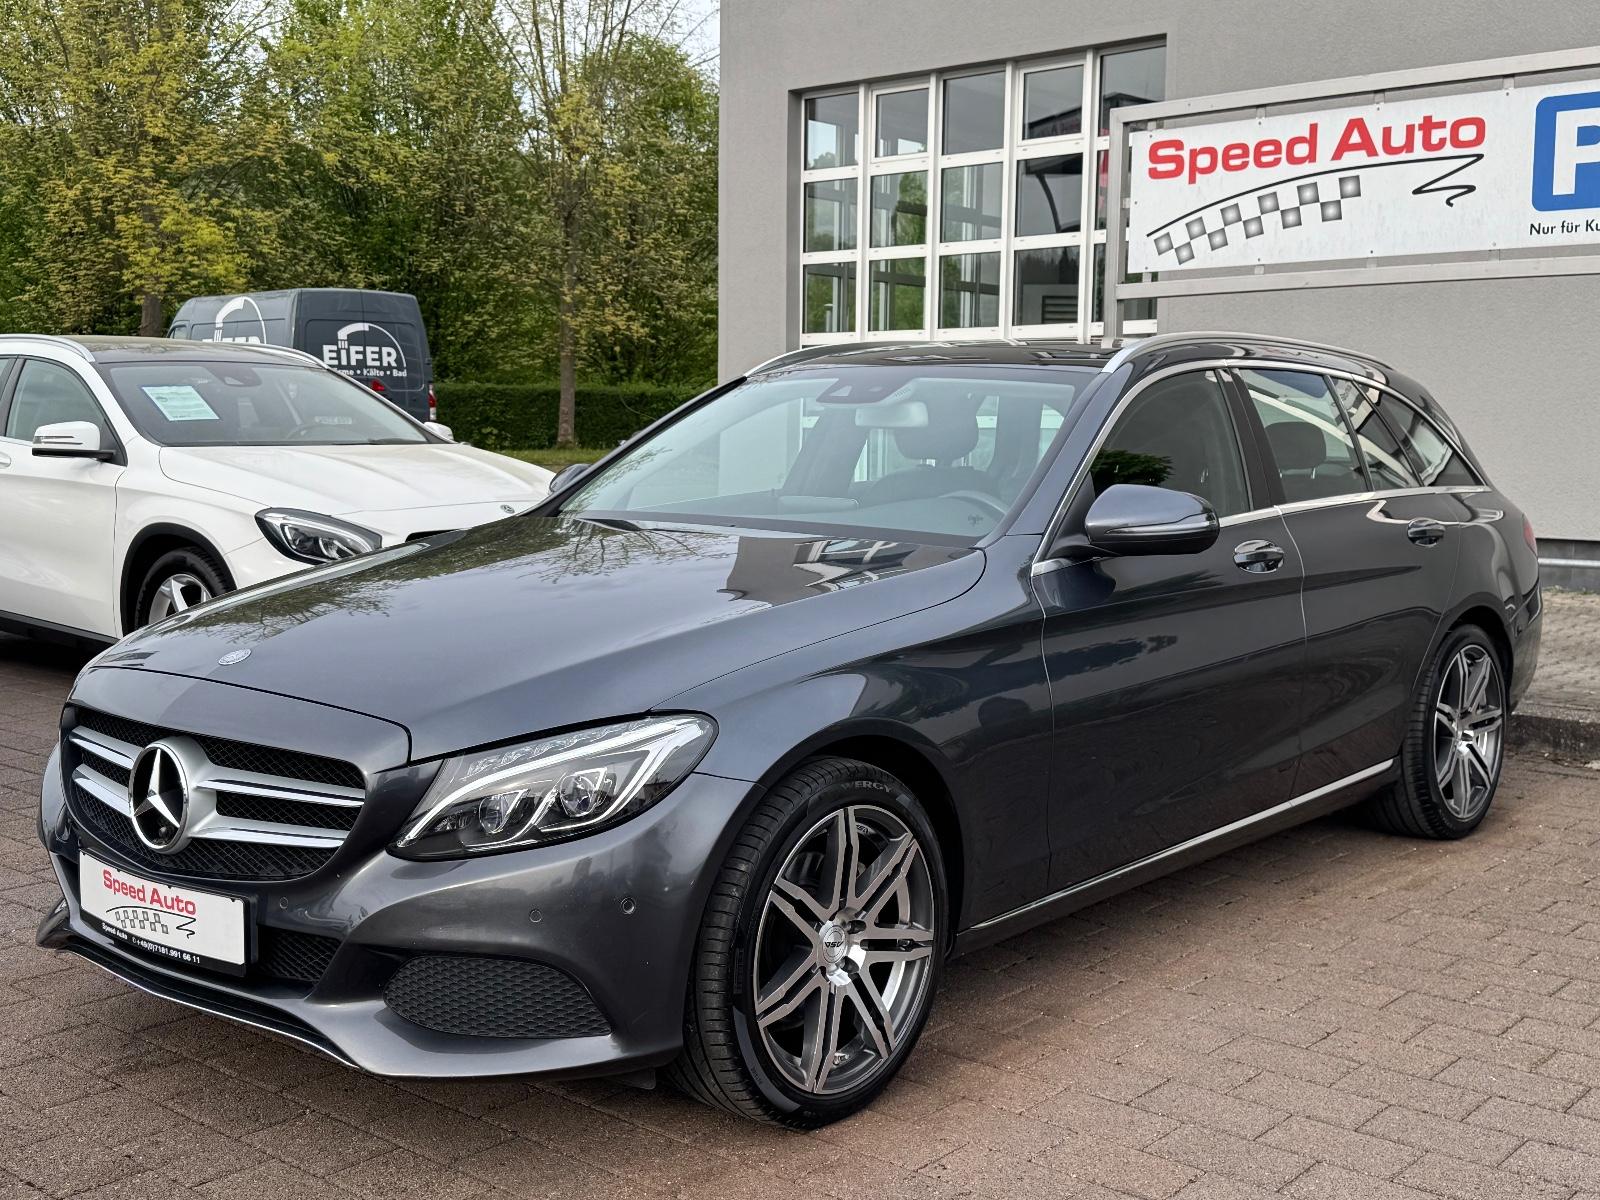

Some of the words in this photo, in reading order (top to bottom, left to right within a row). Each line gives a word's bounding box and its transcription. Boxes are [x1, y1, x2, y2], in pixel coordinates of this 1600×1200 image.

[1148, 122, 1318, 184] Speed
[1331, 115, 1486, 161] Auto
[1552, 107, 1600, 195] P
[1529, 222, 1556, 236] Nur
[1561, 220, 1580, 234] für
[1585, 218, 1600, 232] Ku
[363, 368, 384, 376] Kälte
[392, 369, 407, 377] Bad
[103, 869, 146, 903] Speed
[150, 887, 196, 915] Auto
[102, 922, 117, 935] Speed
[116, 930, 128, 940] Auto
[192, 956, 200, 964] 11
